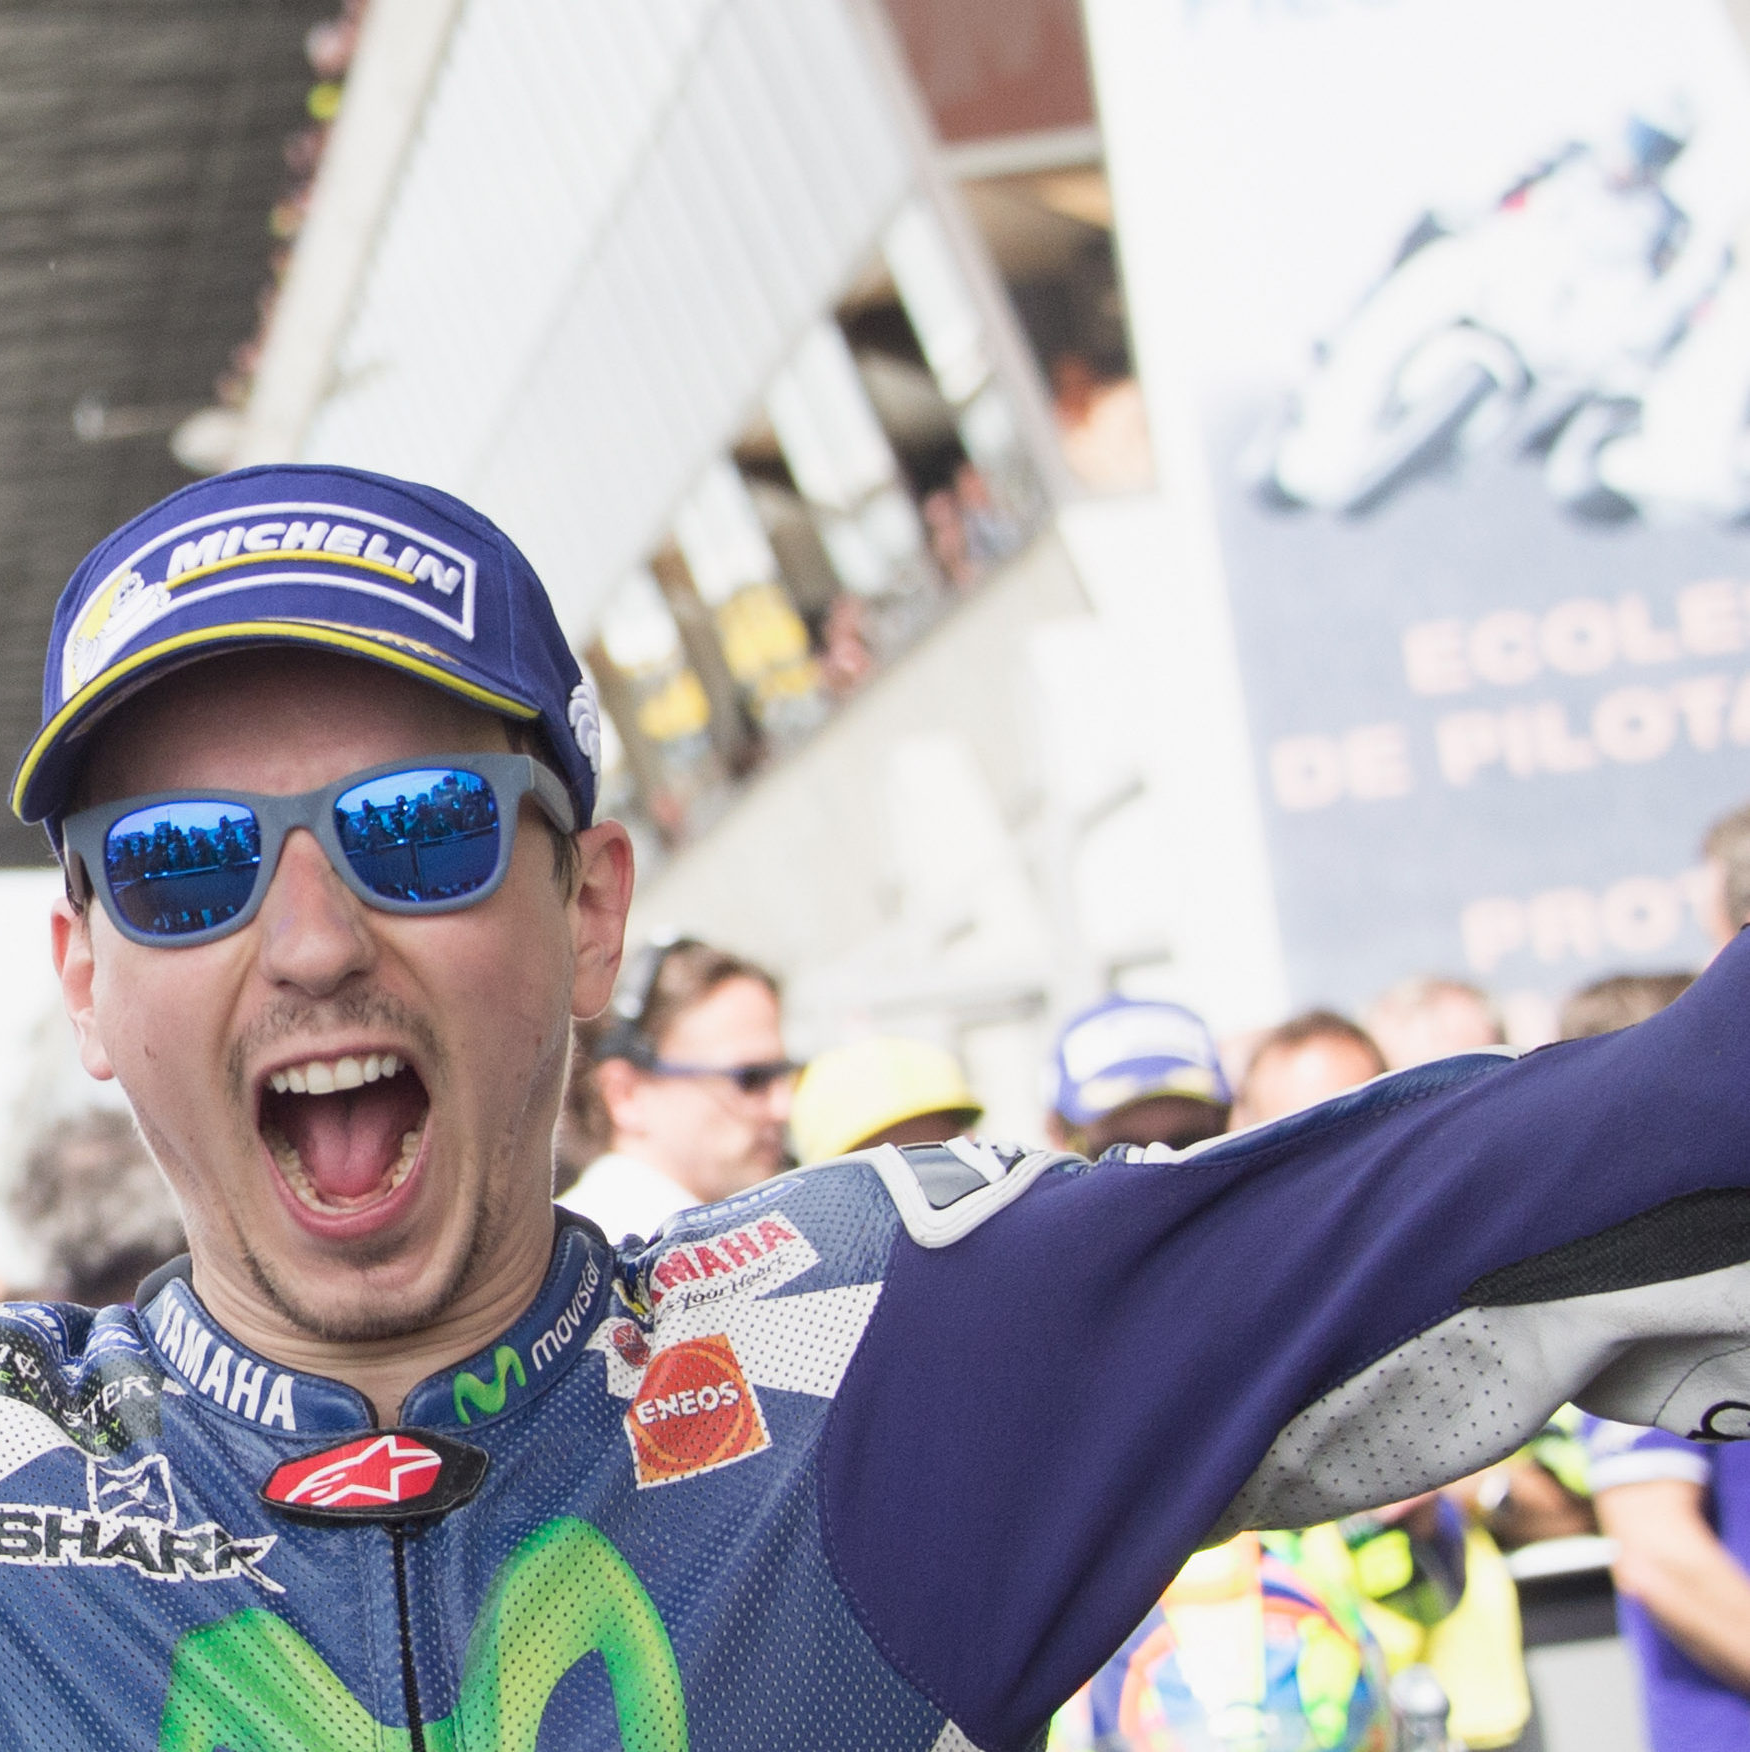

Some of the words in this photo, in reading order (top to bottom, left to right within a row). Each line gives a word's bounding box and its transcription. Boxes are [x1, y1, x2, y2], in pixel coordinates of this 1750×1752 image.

[167, 521, 462, 595] MICHELIN
[1403, 580, 1750, 694] ECOLE
[1271, 726, 1414, 811] DE
[651, 1219, 797, 1305] MAHA
[531, 1250, 601, 1372] movistar
[154, 1290, 297, 1432] YAMAHA
[635, 1381, 741, 1426] ENEOS
